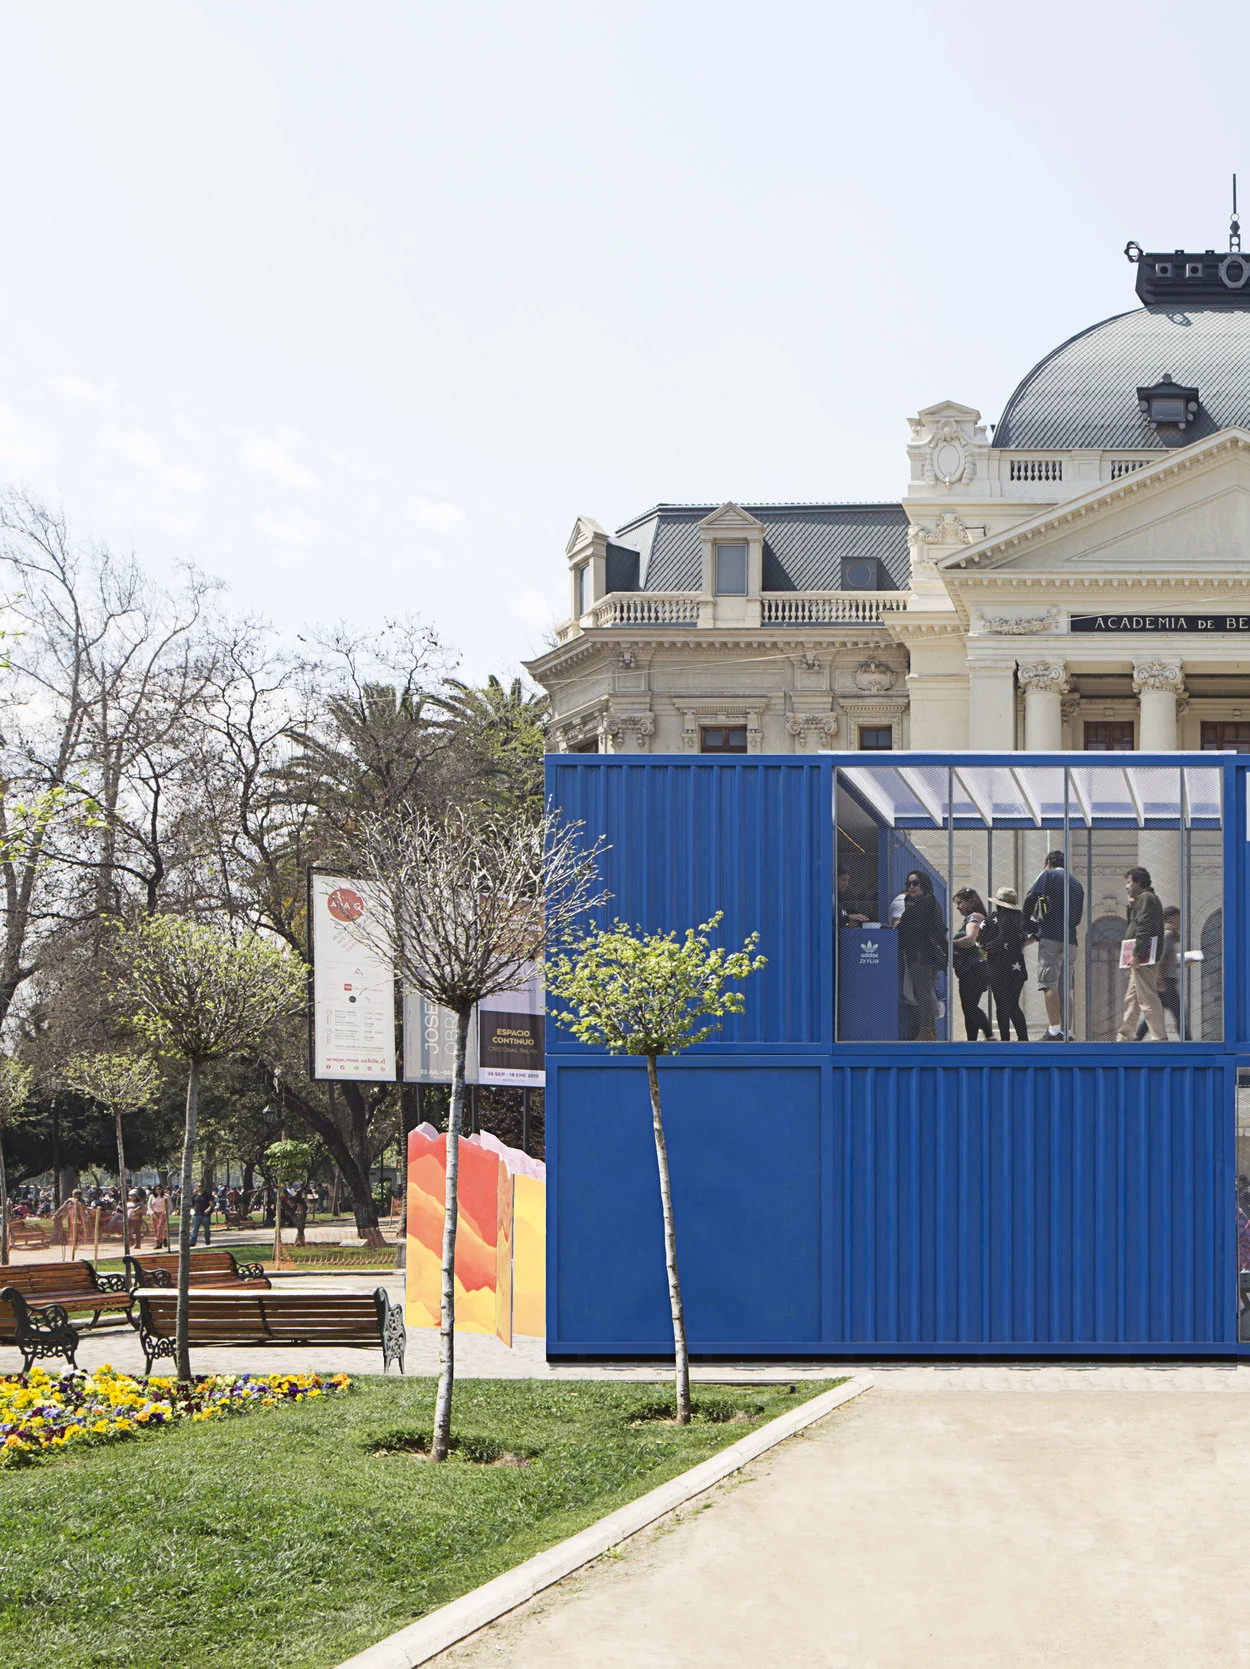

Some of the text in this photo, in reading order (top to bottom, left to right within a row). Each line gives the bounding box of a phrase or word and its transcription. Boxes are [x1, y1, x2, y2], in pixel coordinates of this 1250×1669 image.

[1093, 617, 1188, 630] ACADEMIA
[1197, 619, 1216, 630] DE
[496, 1028, 531, 1037] ESPACIO
[492, 1036, 535, 1046] CONTINUO
